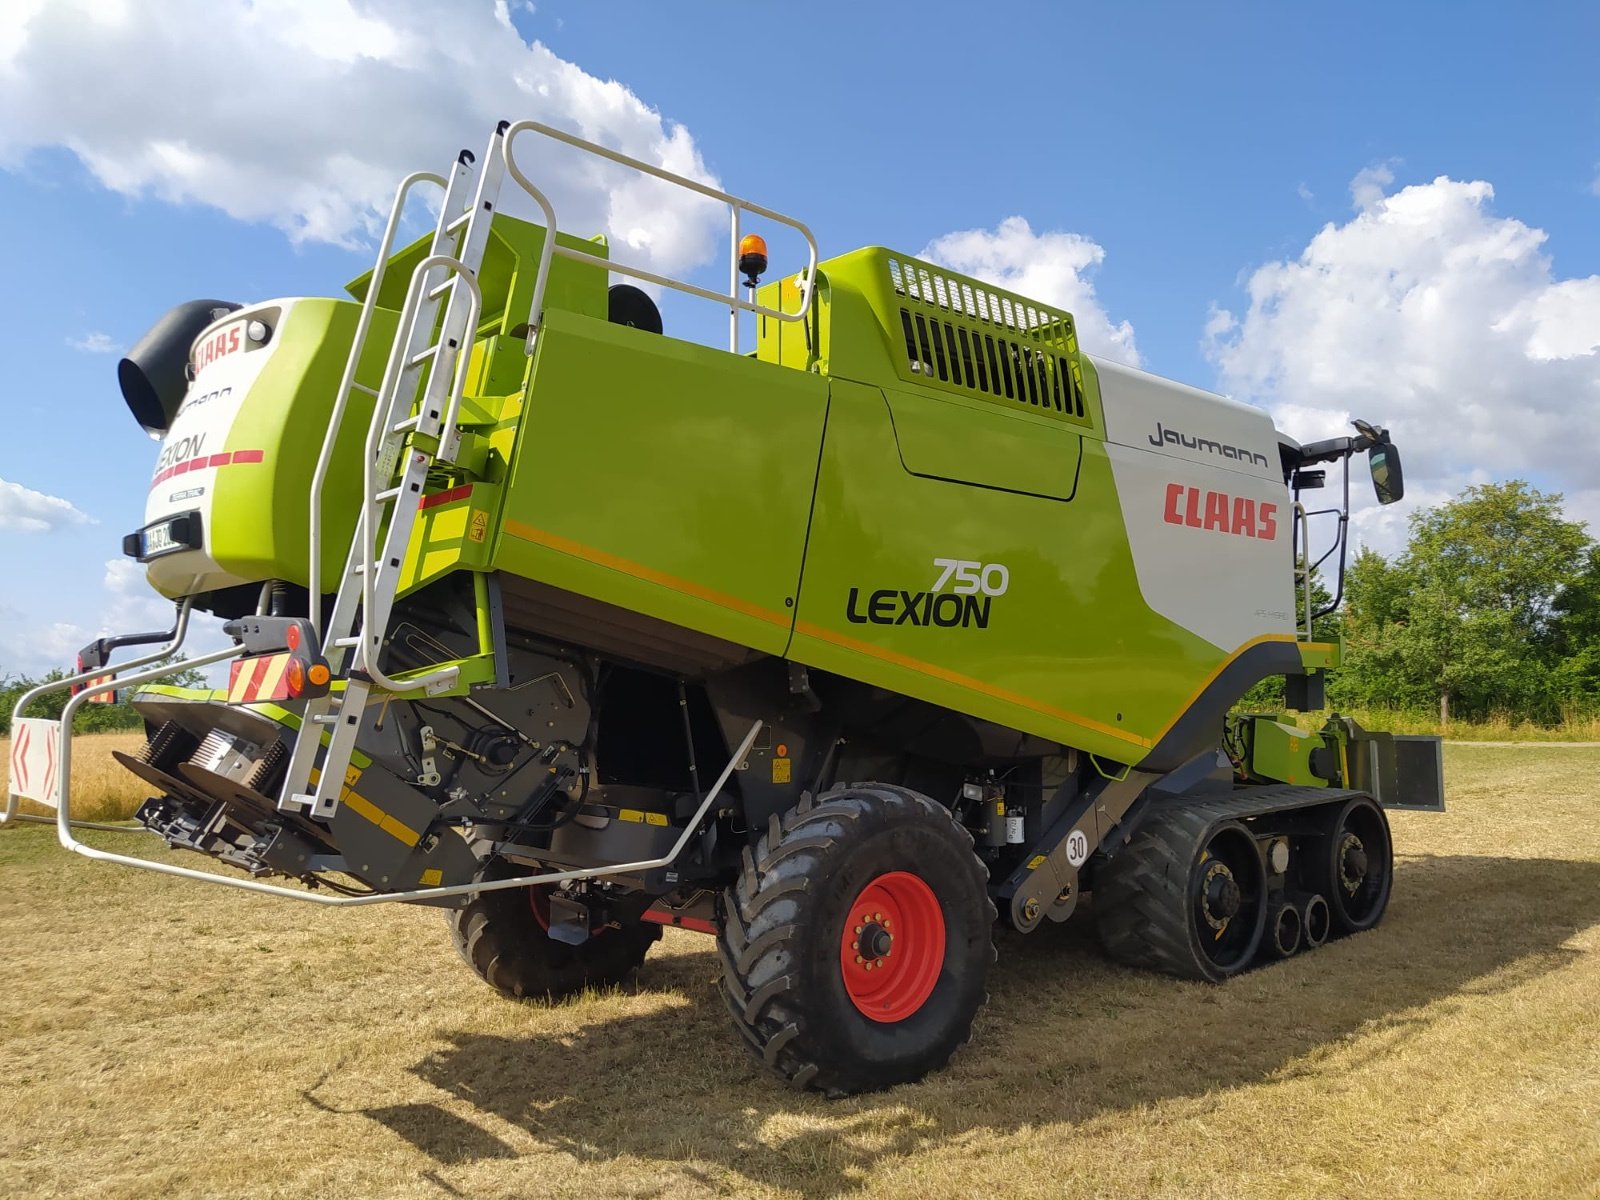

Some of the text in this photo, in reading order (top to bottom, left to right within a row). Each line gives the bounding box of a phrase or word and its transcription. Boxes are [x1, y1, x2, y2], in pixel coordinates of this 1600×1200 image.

[1148, 422, 1268, 468] Jaumann
[1163, 482, 1277, 541] CLAAS
[931, 558, 1009, 596] 750
[846, 587, 991, 629] LEXION
[1069, 836, 1084, 861] 30
